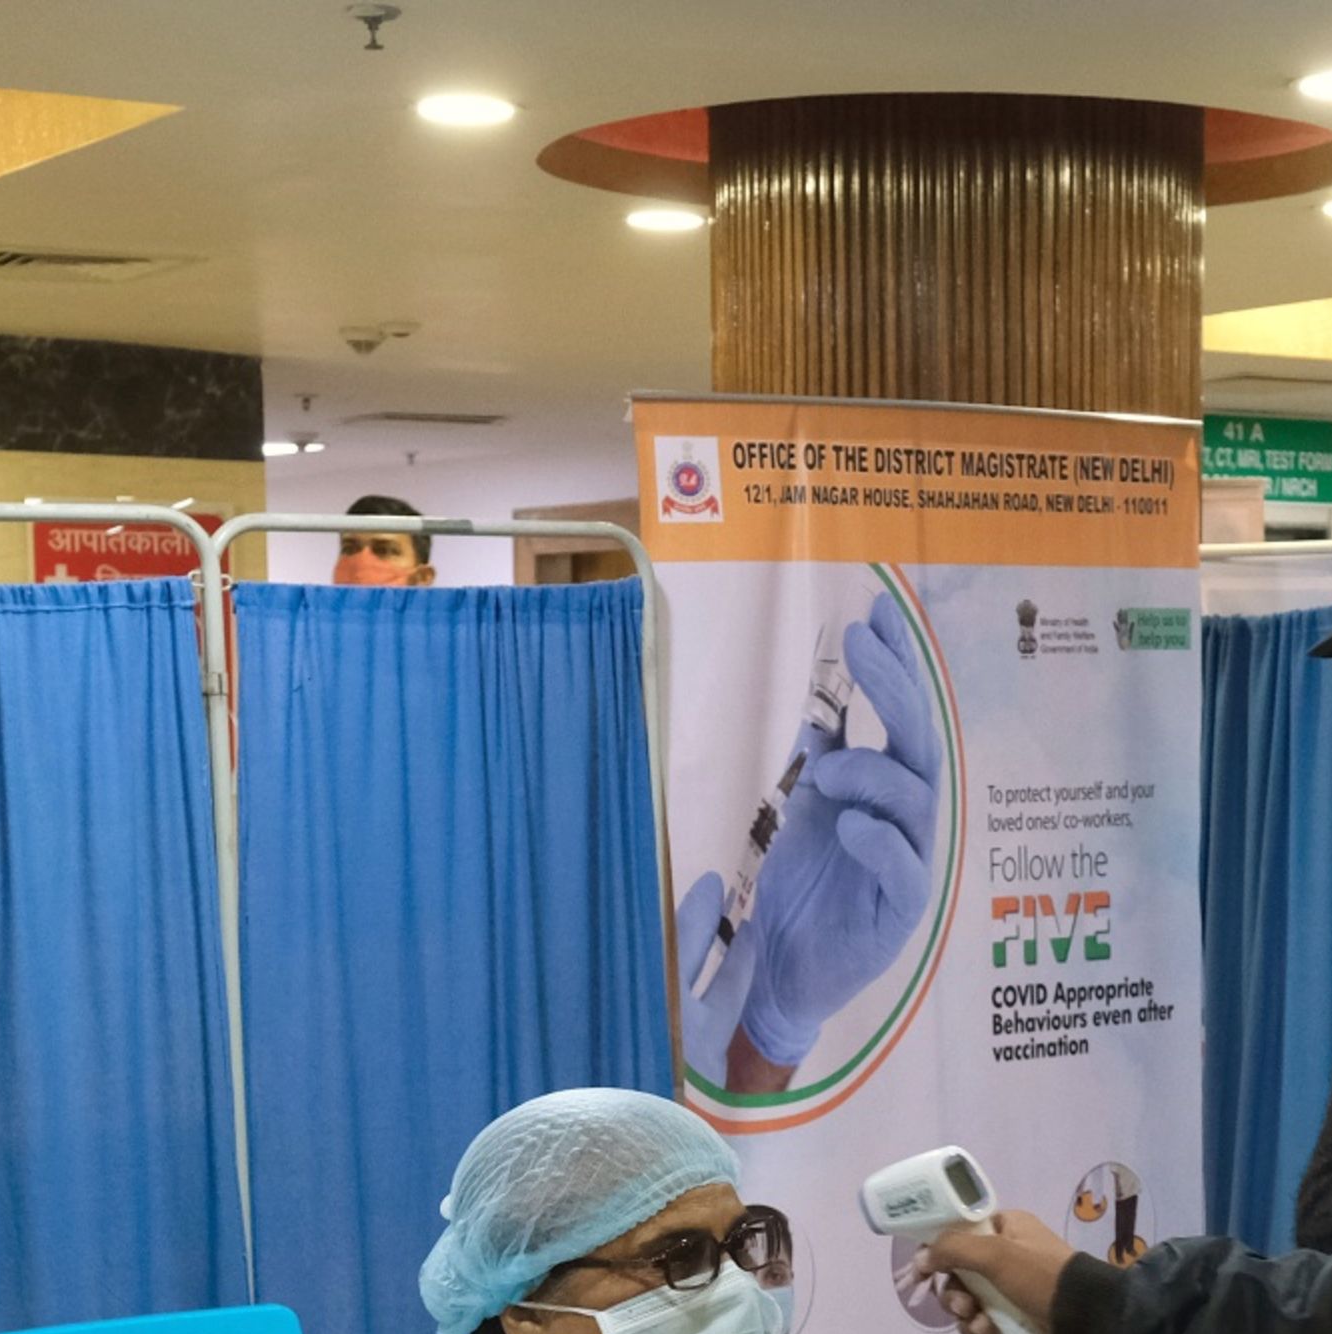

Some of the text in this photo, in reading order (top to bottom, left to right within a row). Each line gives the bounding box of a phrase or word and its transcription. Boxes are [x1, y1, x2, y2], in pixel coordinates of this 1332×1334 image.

[1223, 421, 1265, 442] 41 A
[733, 442, 797, 470] OFFICE
[804, 443, 826, 470] OF
[832, 445, 869, 473] THE
[875, 447, 955, 476] DISTRICT
[961, 451, 1068, 480] MAGISTRATE
[1073, 455, 1114, 486] (NEW
[1119, 457, 1175, 490] DELHI)
[1265, 450, 1295, 471] TEST
[743, 484, 777, 507] 12/1,
[779, 485, 806, 505] JAM
[811, 486, 859, 506] NAGAR
[863, 488, 914, 510] HOUSE,
[918, 489, 999, 511] SHAHJAHAN
[1003, 492, 1042, 515] ROAD,
[1046, 494, 1074, 513] NEW
[1077, 495, 1114, 514] DELHI
[1123, 497, 1168, 515] 110011
[48, 526, 191, 556] आपातकाली
[987, 780, 1156, 807] To protect yourself and your
[988, 809, 1134, 832] loved ones/ co-workers,
[989, 843, 1109, 883] Follow the
[991, 890, 1112, 968] FIVE
[991, 977, 1154, 1010] COVID Appropriate
[992, 999, 1175, 1036] Behaviours even after
[992, 1036, 1089, 1062] vaccination
